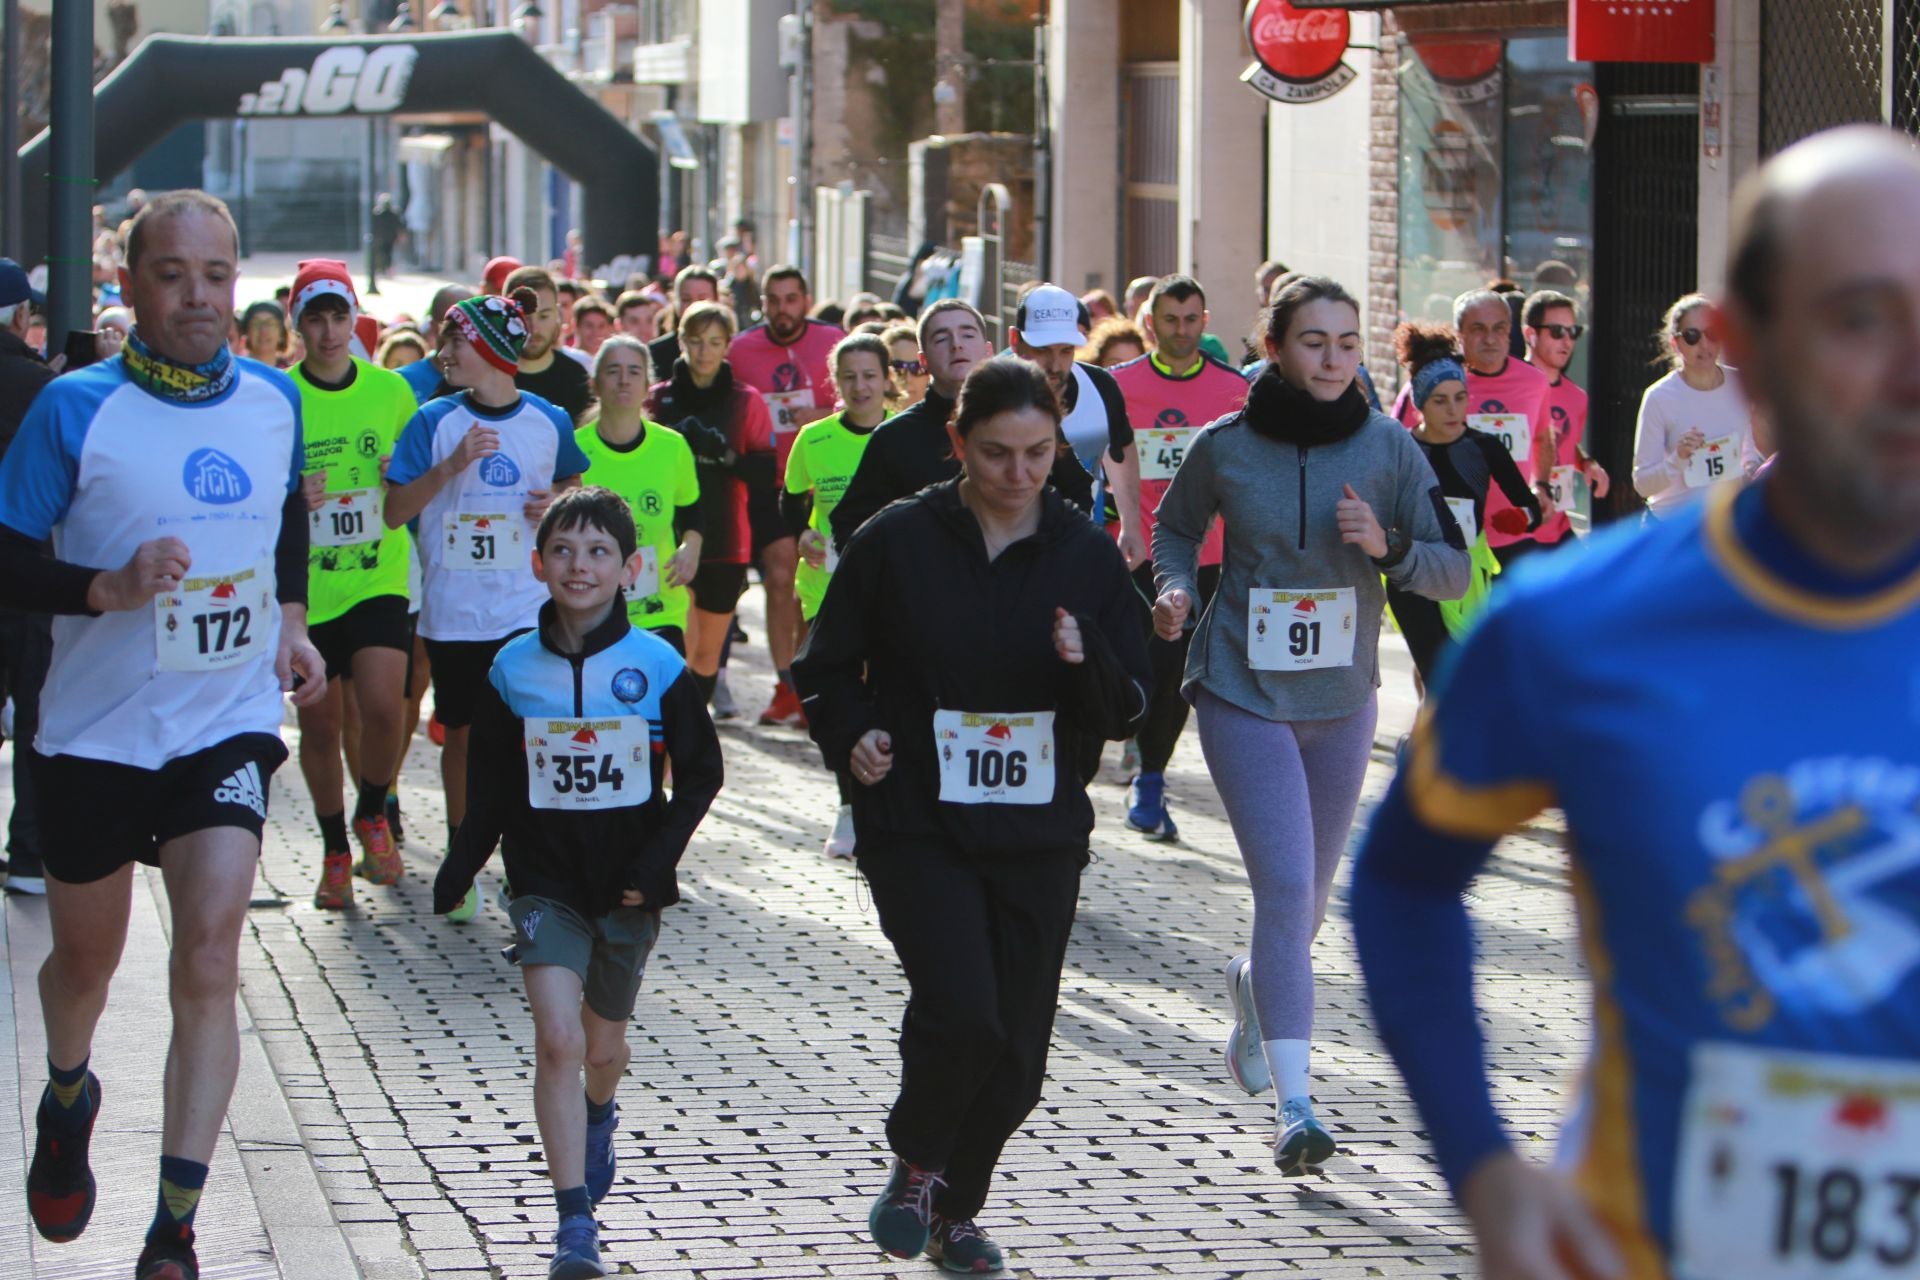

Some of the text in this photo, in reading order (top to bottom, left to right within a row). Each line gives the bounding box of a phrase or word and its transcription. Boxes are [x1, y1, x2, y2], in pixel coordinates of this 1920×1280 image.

[1156, 448, 1184, 469] 45
[1705, 456, 1725, 477] 15
[331, 511, 363, 536] 101
[471, 535, 495, 560] 31
[193, 606, 251, 654] 172
[1289, 621, 1320, 656] 91
[551, 754, 624, 794] 354
[966, 749, 1027, 788] 106
[1770, 1161, 1920, 1266] 183
